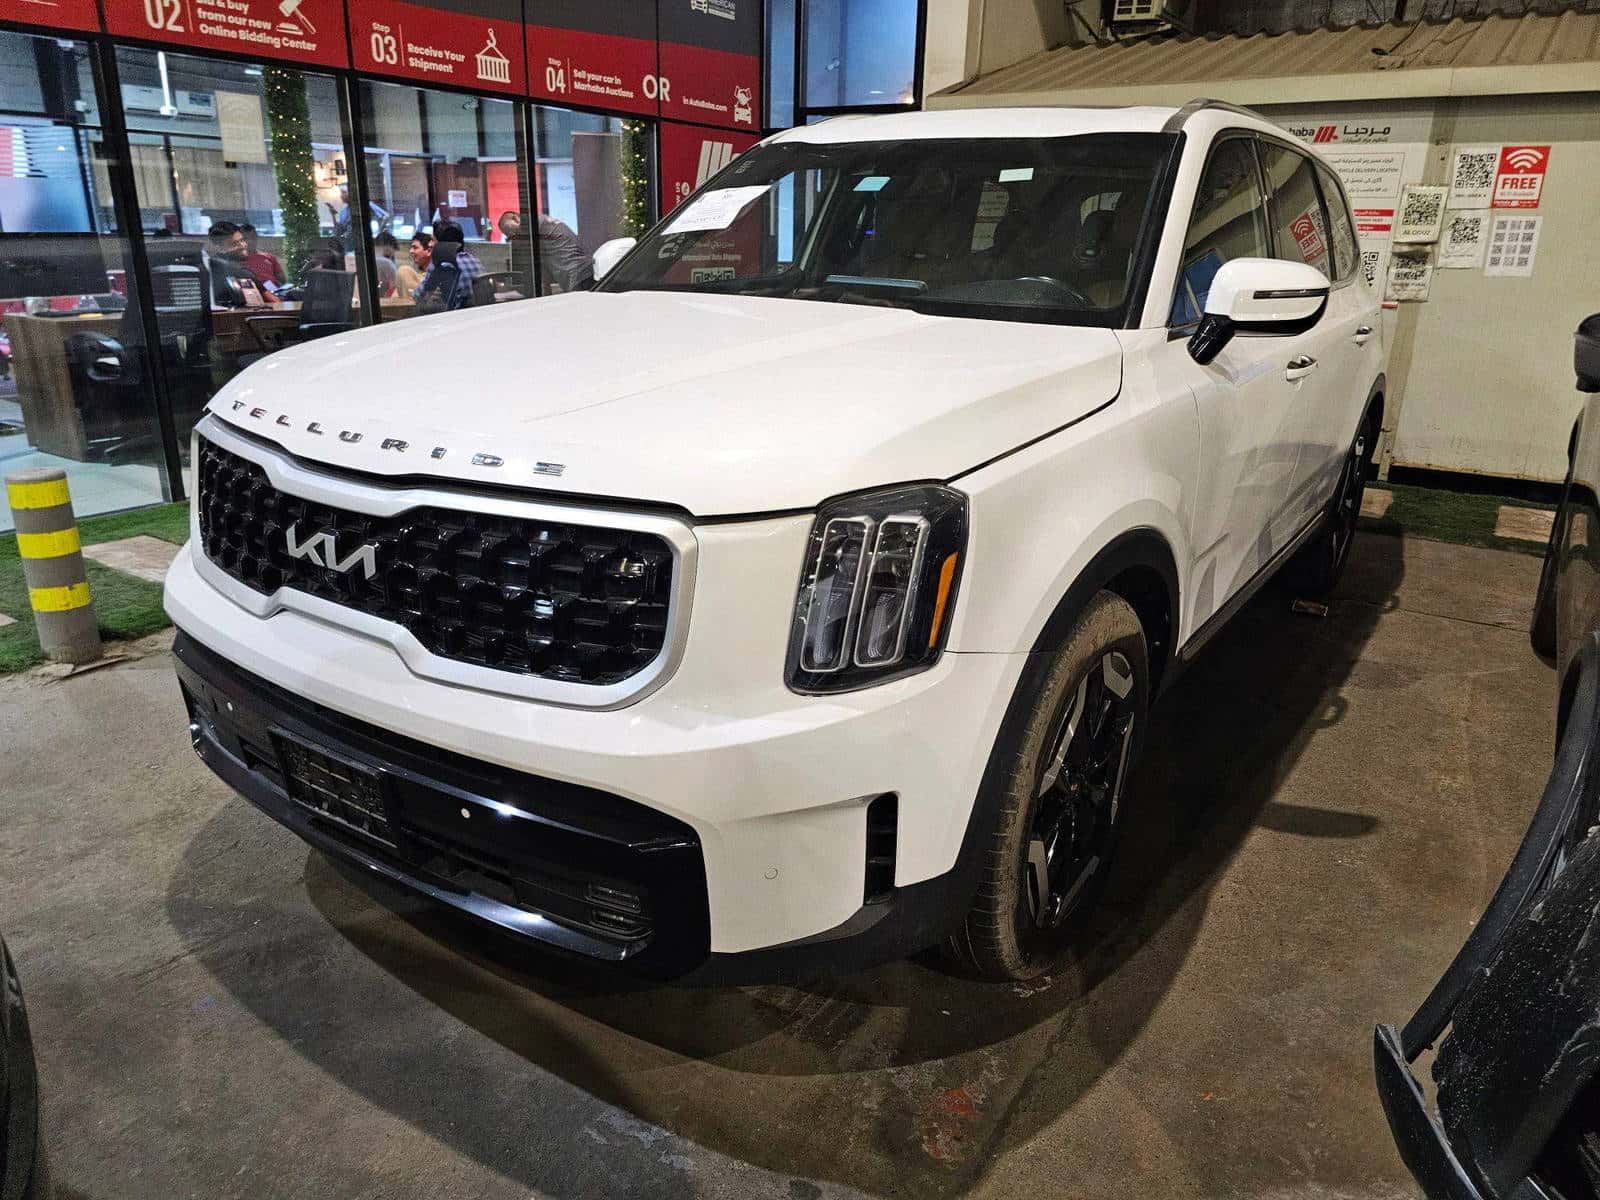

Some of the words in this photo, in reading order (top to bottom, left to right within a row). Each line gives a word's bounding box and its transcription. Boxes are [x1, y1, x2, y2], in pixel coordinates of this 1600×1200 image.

[144, 0, 185, 32] 02
[227, 0, 249, 15] buy
[197, 7, 226, 22] from
[227, 14, 248, 26] our
[248, 17, 272, 30] new
[372, 22, 391, 34] Step
[199, 24, 238, 40] Online
[238, 30, 281, 48] Bidding
[281, 36, 317, 51] Center
[370, 32, 398, 65] 03
[407, 42, 444, 58] Receive
[444, 49, 466, 62] Your
[408, 57, 454, 73] Shipment
[546, 66, 566, 94] 04
[573, 68, 587, 80] Sell
[587, 71, 603, 82] your
[602, 75, 615, 85] car
[614, 75, 622, 85] in
[574, 81, 605, 94] Marhaba
[605, 86, 635, 99] Auctions
[642, 73, 671, 102] OR
[1343, 125, 1392, 137] مرحبا
[1501, 177, 1538, 190] FREE
[232, 399, 567, 477] TELLURIDE
[285, 521, 376, 580] KIA
